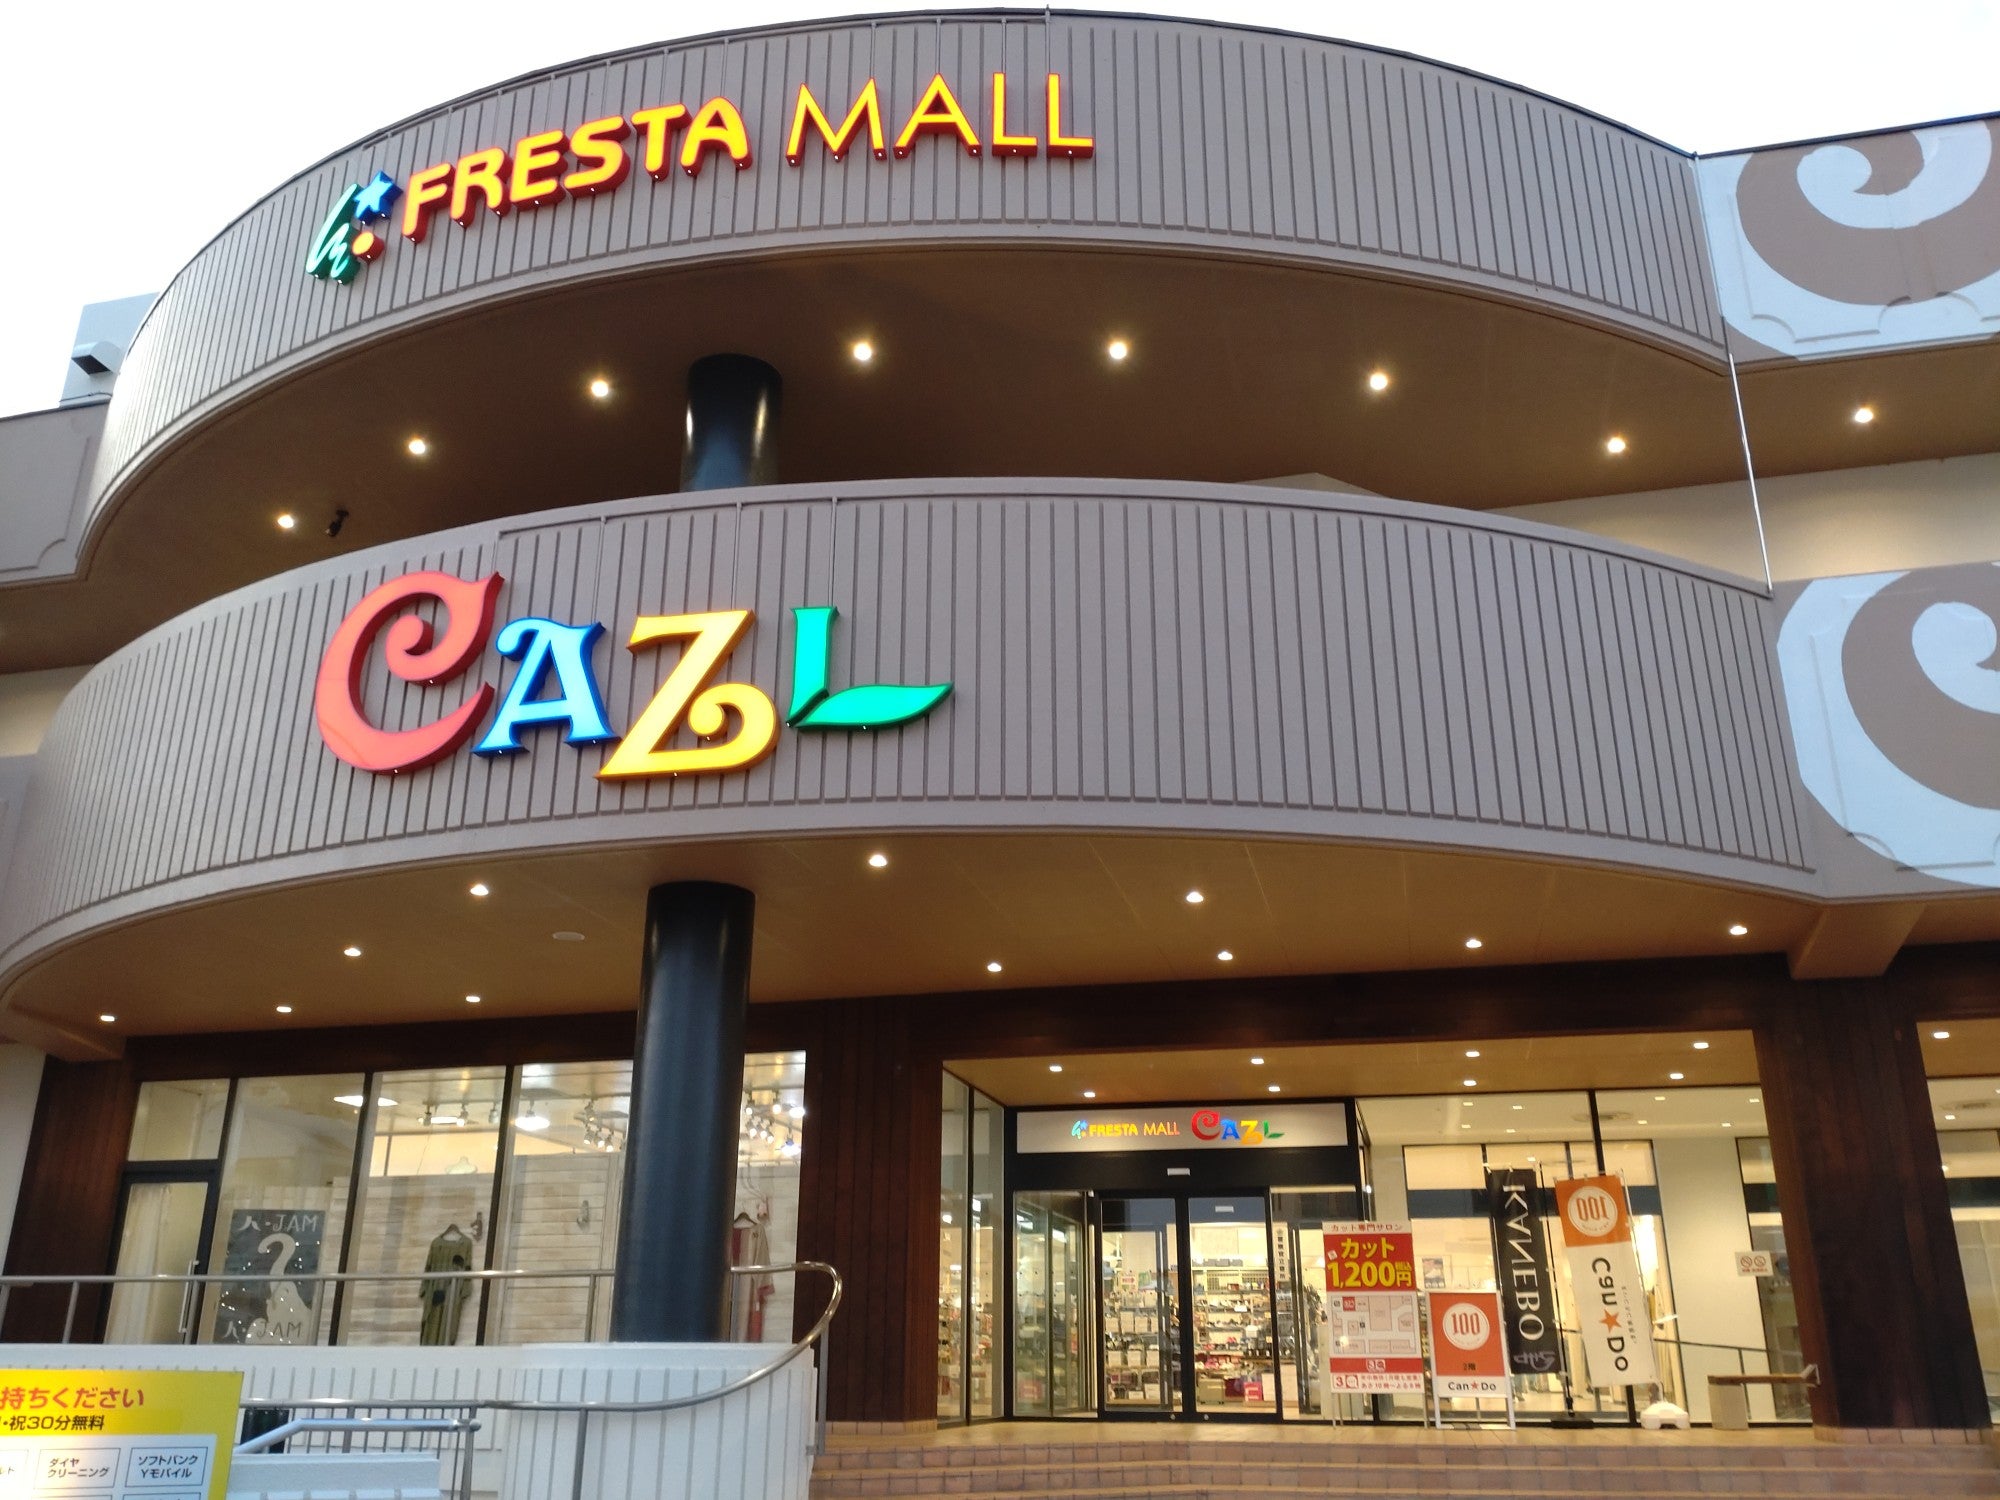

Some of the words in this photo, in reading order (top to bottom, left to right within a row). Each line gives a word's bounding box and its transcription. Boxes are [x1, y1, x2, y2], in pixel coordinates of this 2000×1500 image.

[402, 96, 753, 243] FRESTA
[787, 72, 1094, 167] MALL
[315, 570, 954, 781] CAZL
[1089, 1123, 1138, 1137] FRESTA
[1143, 1121, 1180, 1136] MALL
[1191, 1109, 1285, 1145] CAZL
[1340, 1237, 1395, 1259] カット
[1451, 1312, 1481, 1336] 100
[0, 1414, 105, 1430] ・祝30分無料
[49, 1457, 80, 1468] ダイヤ
[138, 1455, 198, 1465] ソフトバンク
[47, 1466, 111, 1478] クリーニング
[141, 1467, 192, 1478] Yモバイル
